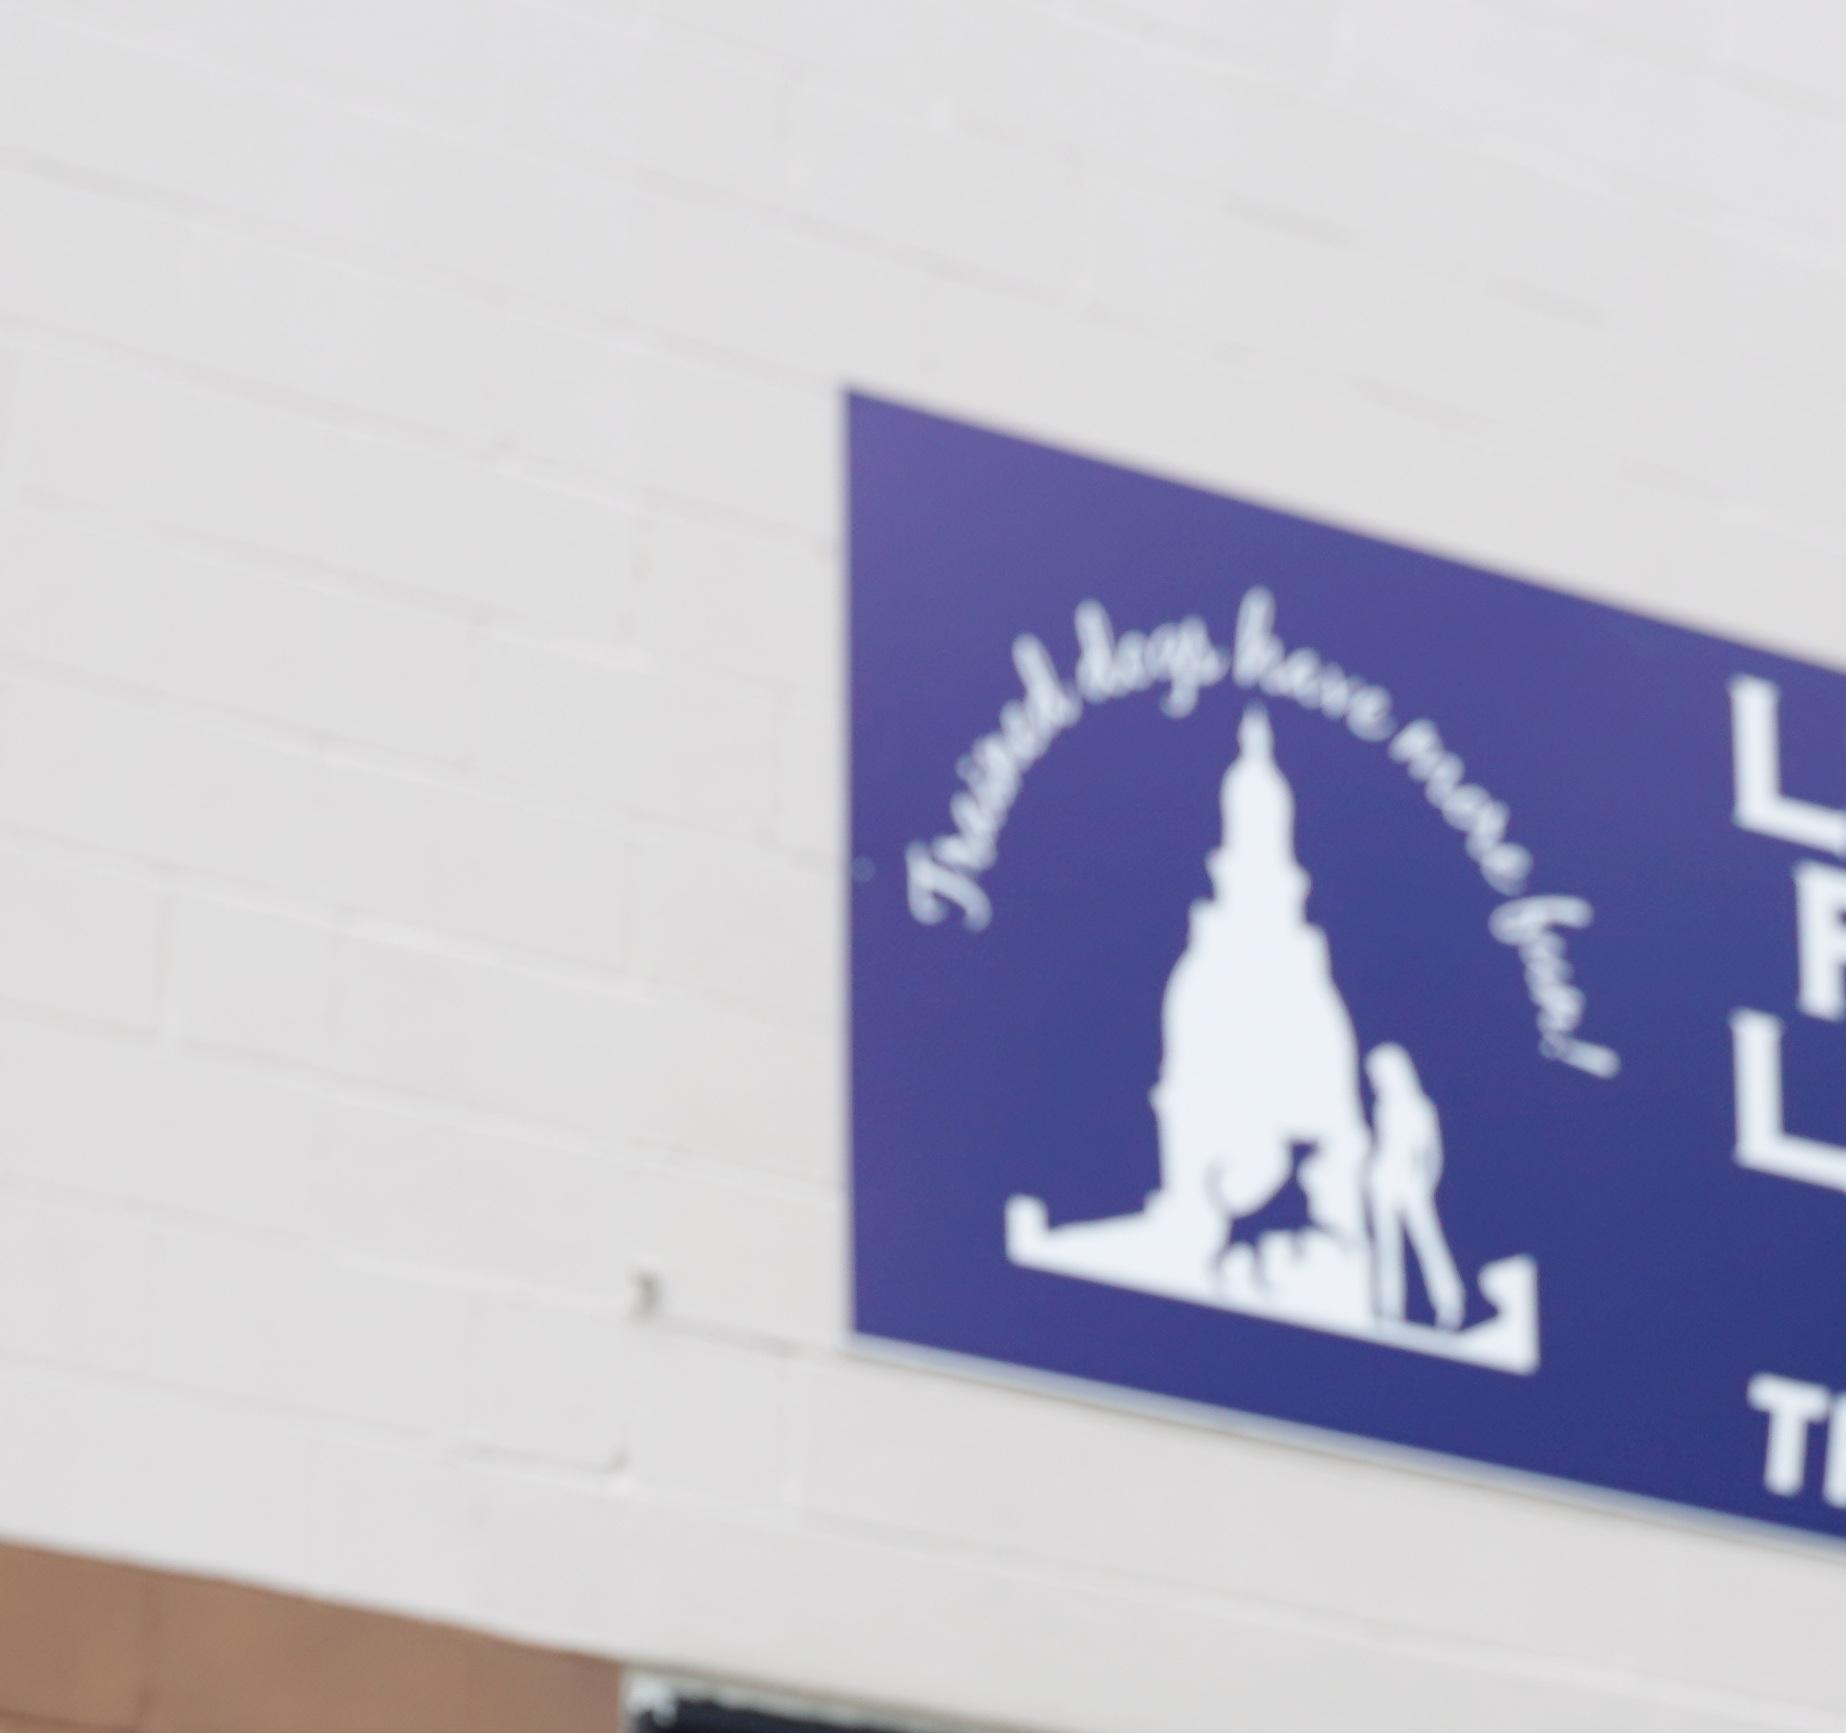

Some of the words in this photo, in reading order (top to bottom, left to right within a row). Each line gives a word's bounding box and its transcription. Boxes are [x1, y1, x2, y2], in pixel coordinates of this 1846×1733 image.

[905, 633, 1082, 931] Trained
[1075, 599, 1229, 718] dogs
[1233, 586, 1396, 741] have
[1389, 719, 1533, 895] more
[1489, 896, 1619, 1077] fun!
